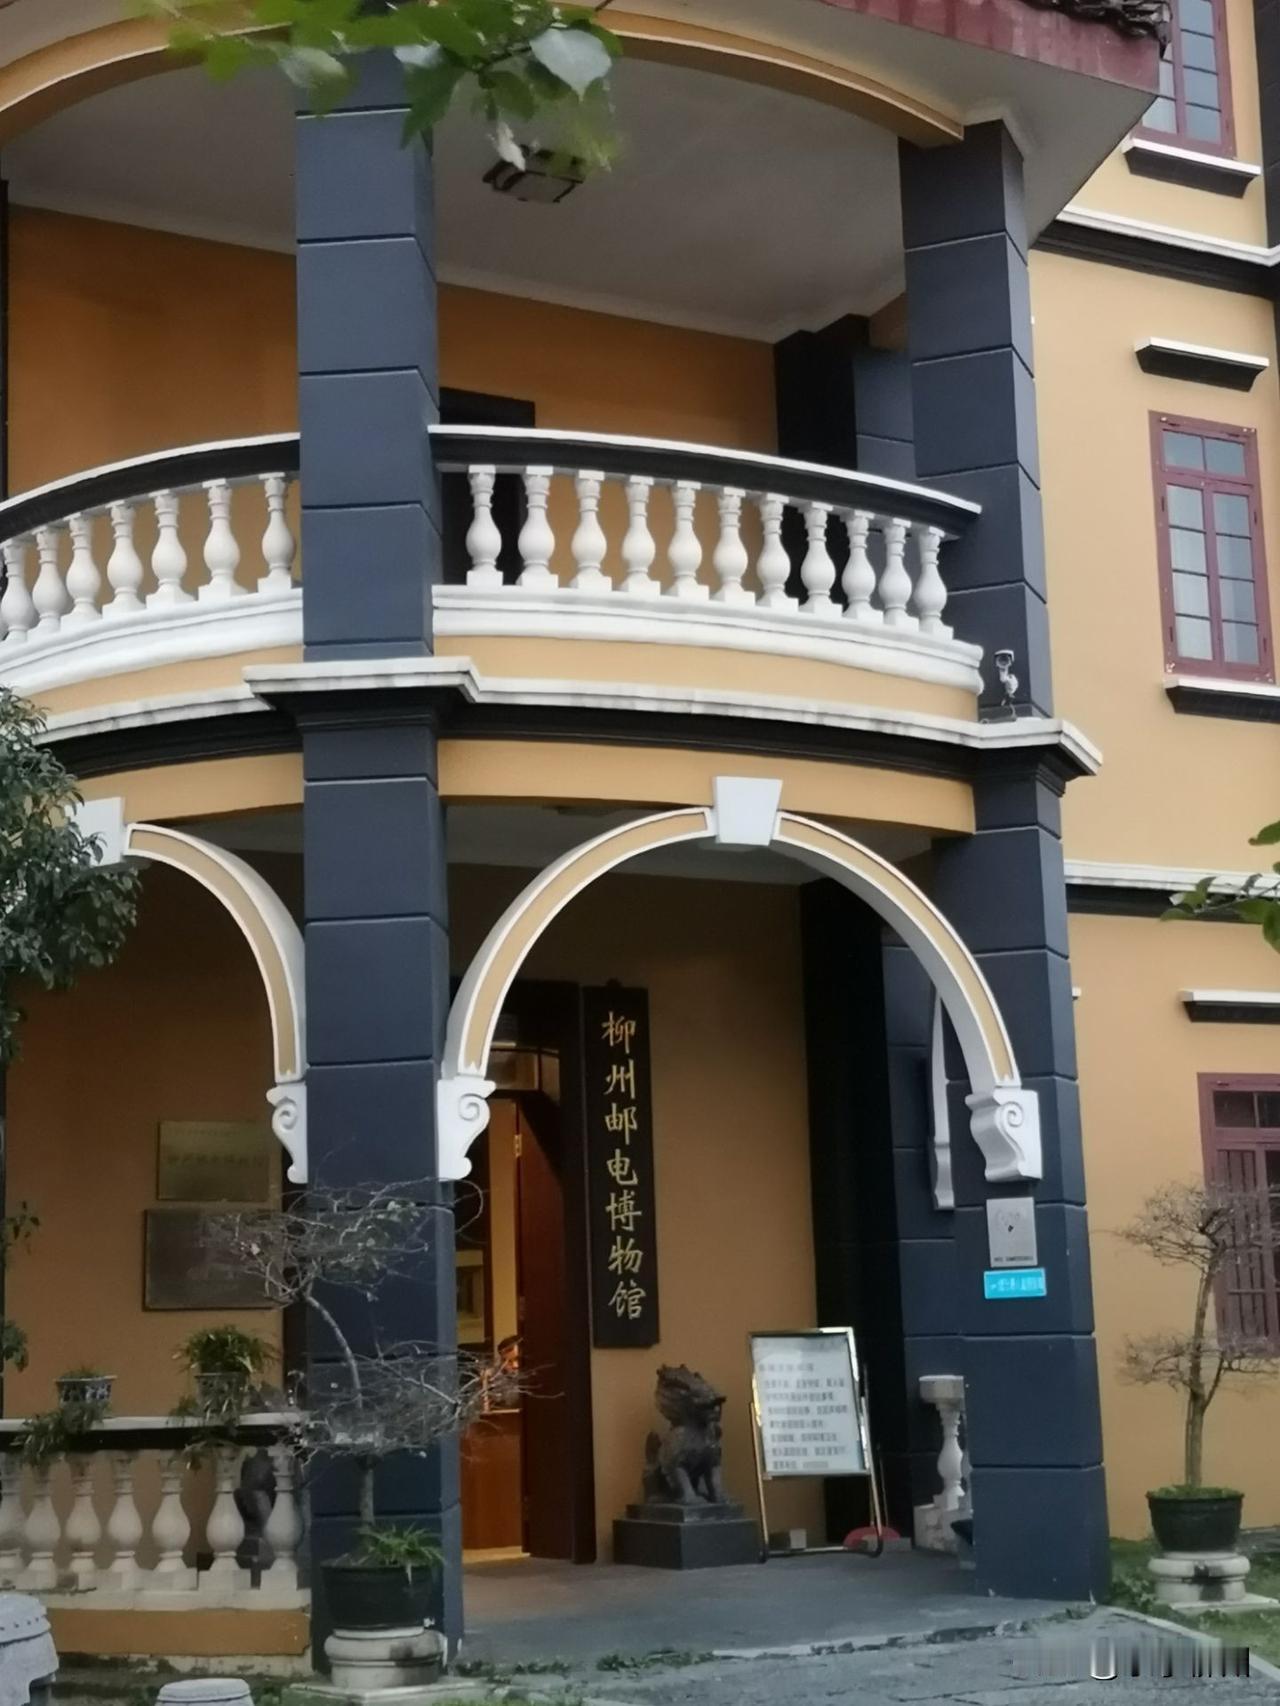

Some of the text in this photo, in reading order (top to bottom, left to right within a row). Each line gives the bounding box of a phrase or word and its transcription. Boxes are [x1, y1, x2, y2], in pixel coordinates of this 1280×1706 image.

[601, 1011, 647, 1320] 柳州邮电博物馆
